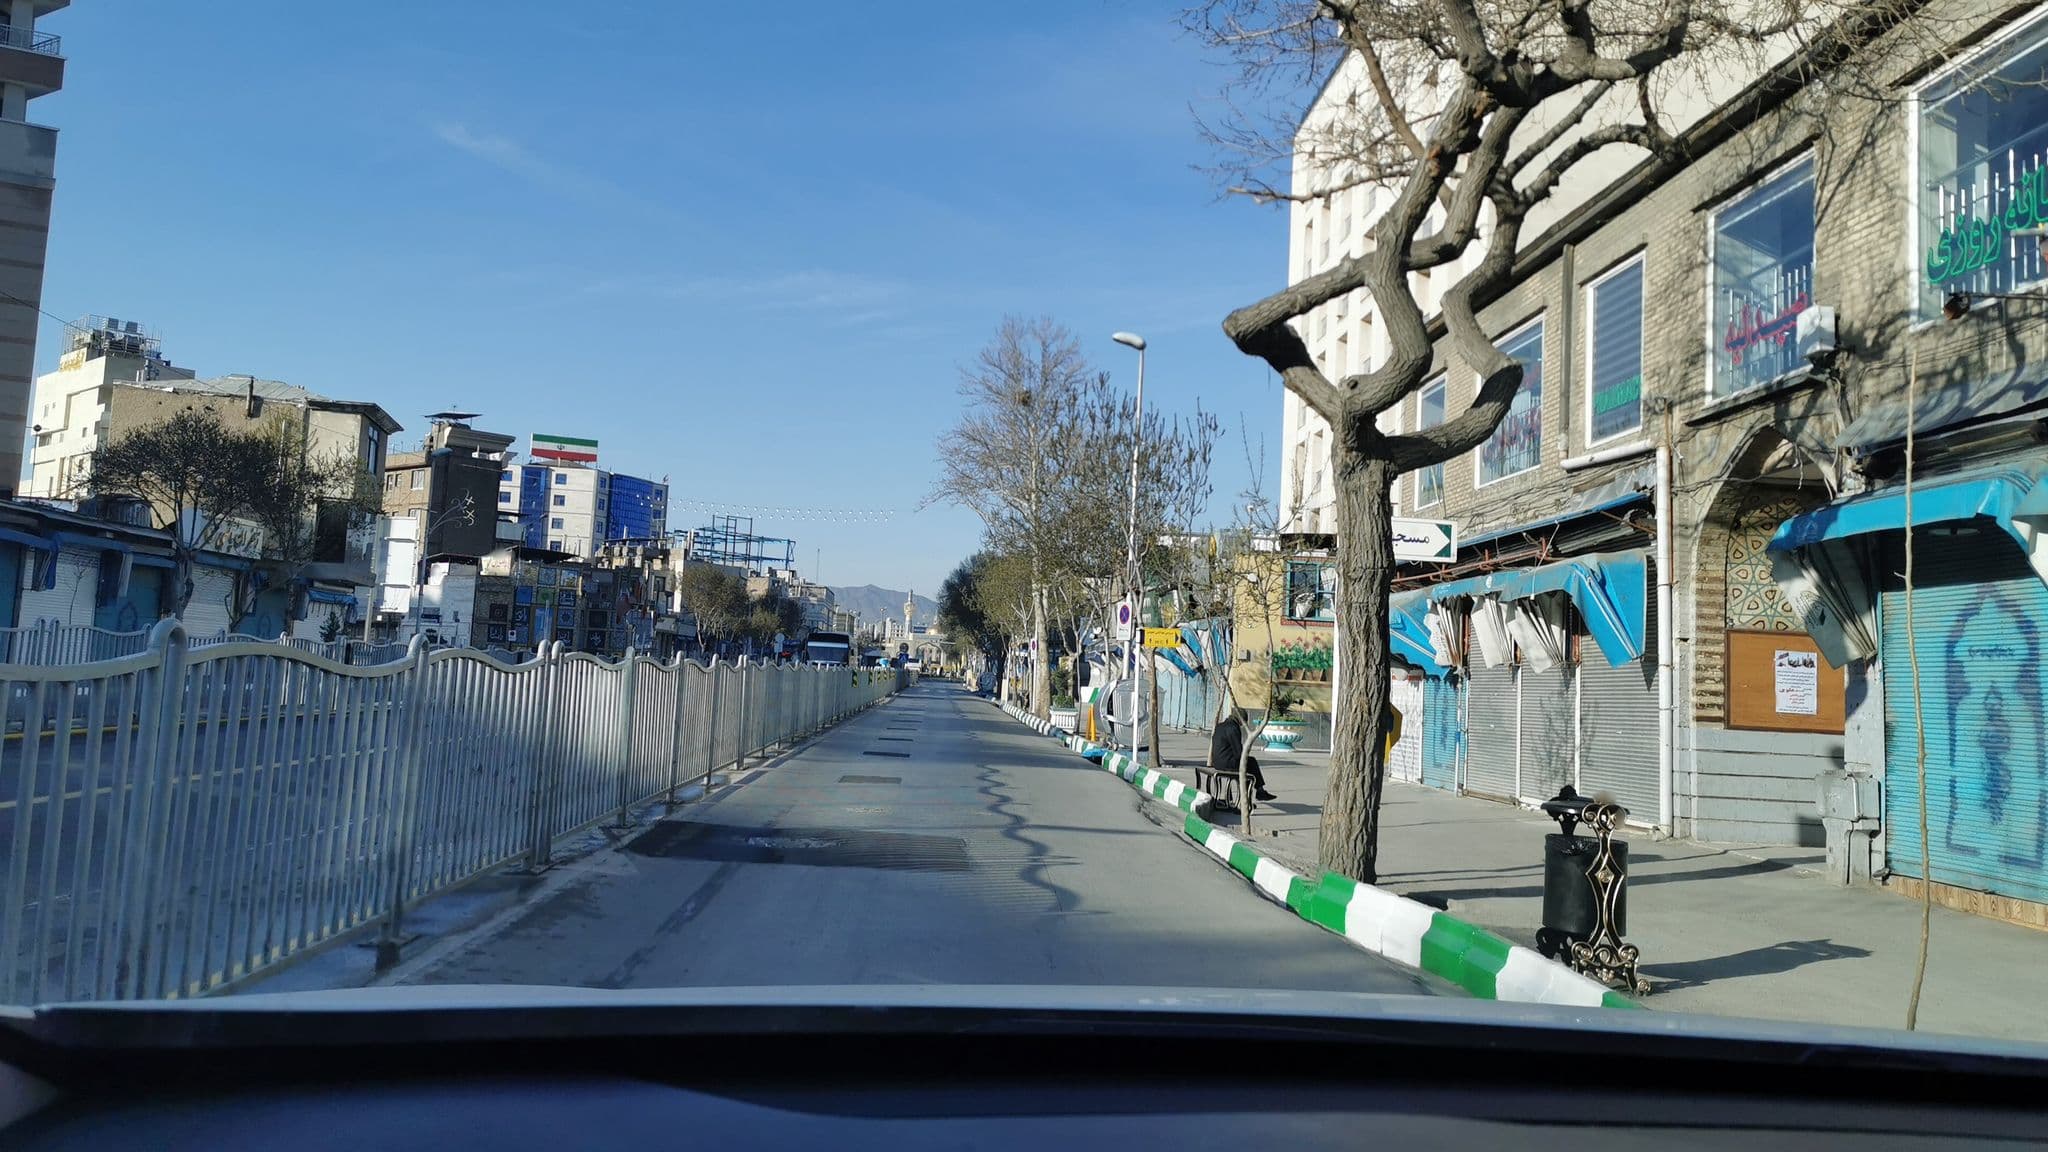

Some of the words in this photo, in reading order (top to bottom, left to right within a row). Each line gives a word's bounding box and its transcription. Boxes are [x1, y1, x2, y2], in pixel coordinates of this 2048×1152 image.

[2005, 164, 2048, 230] انه
[1928, 213, 2001, 283] روزی
[1392, 533, 1430, 547] مسج
